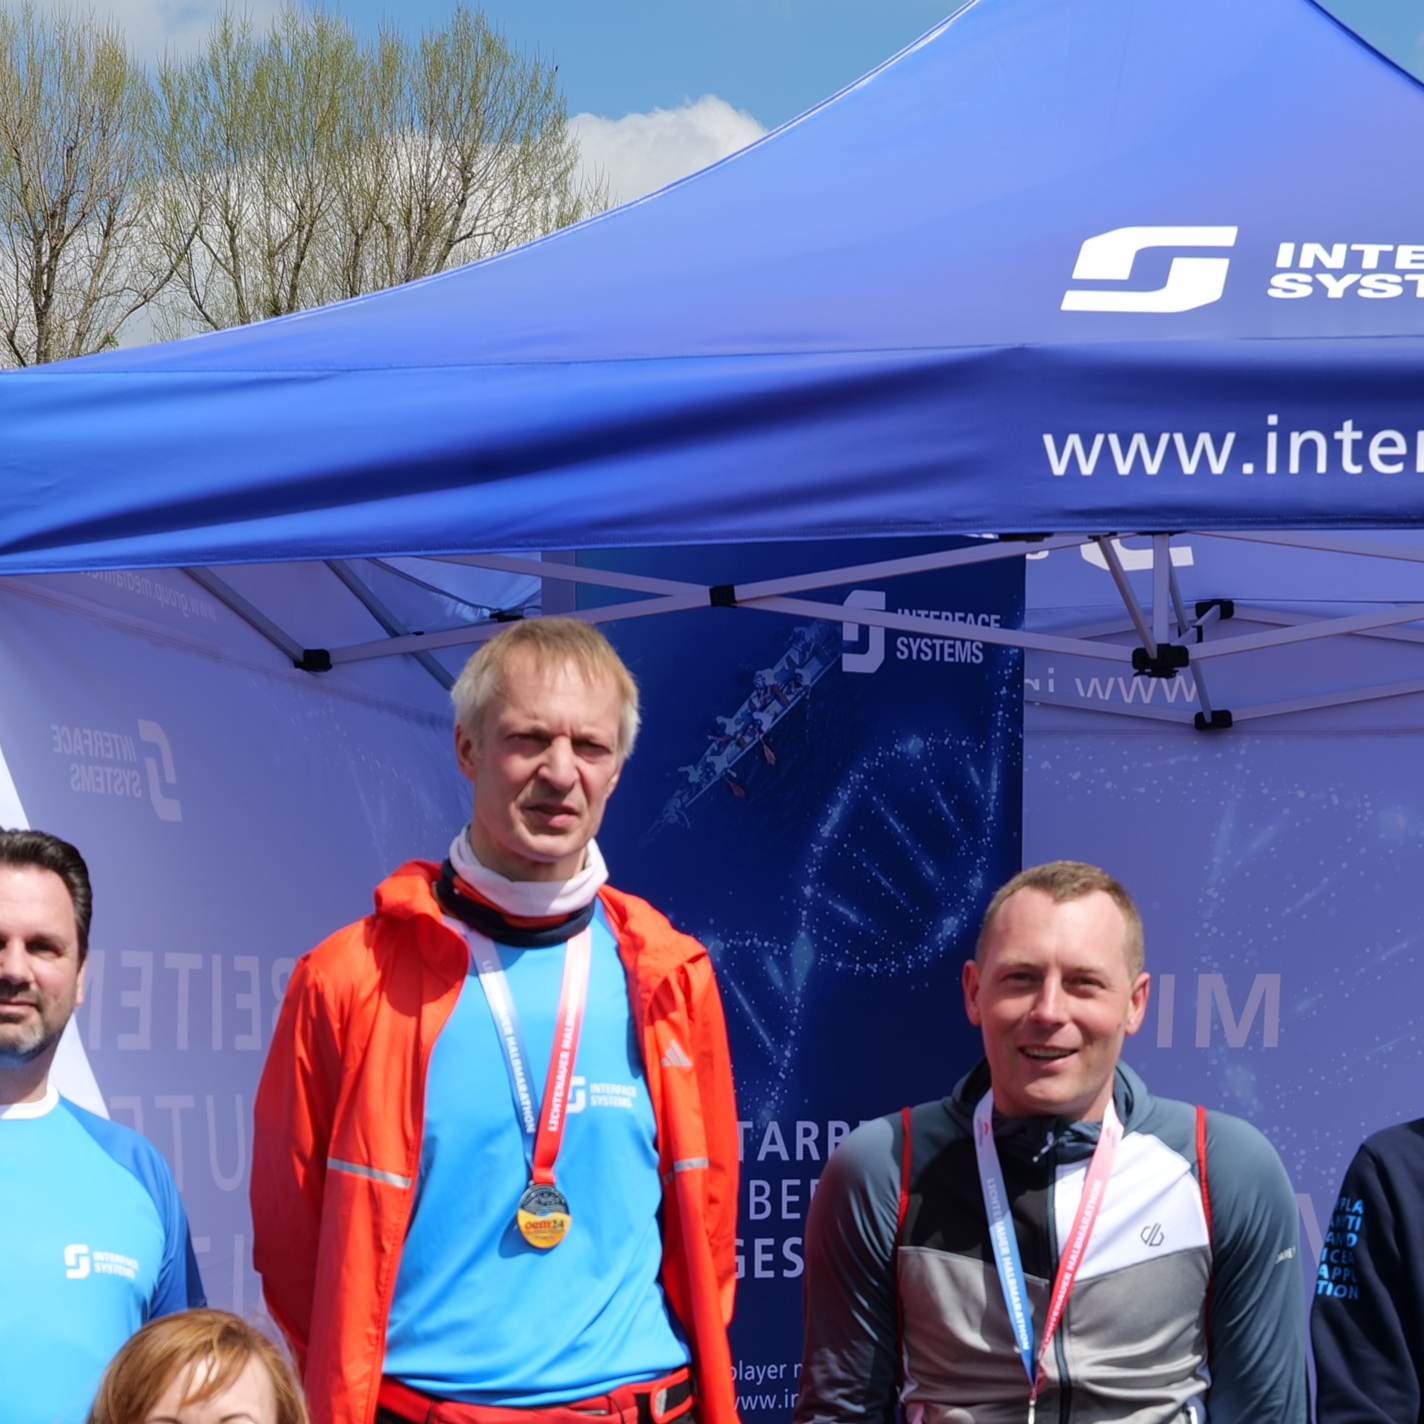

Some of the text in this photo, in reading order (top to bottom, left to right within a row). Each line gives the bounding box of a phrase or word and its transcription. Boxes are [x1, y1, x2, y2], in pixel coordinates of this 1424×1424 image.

[896, 637, 984, 664] SYSTEMS
[506, 1037, 537, 1134] HALBMARATHON
[547, 1054, 573, 1132] LICHTENAUER
[1064, 1179, 1104, 1273] HALBMARATHON
[1002, 1255, 1030, 1352] HALBMARATHON
